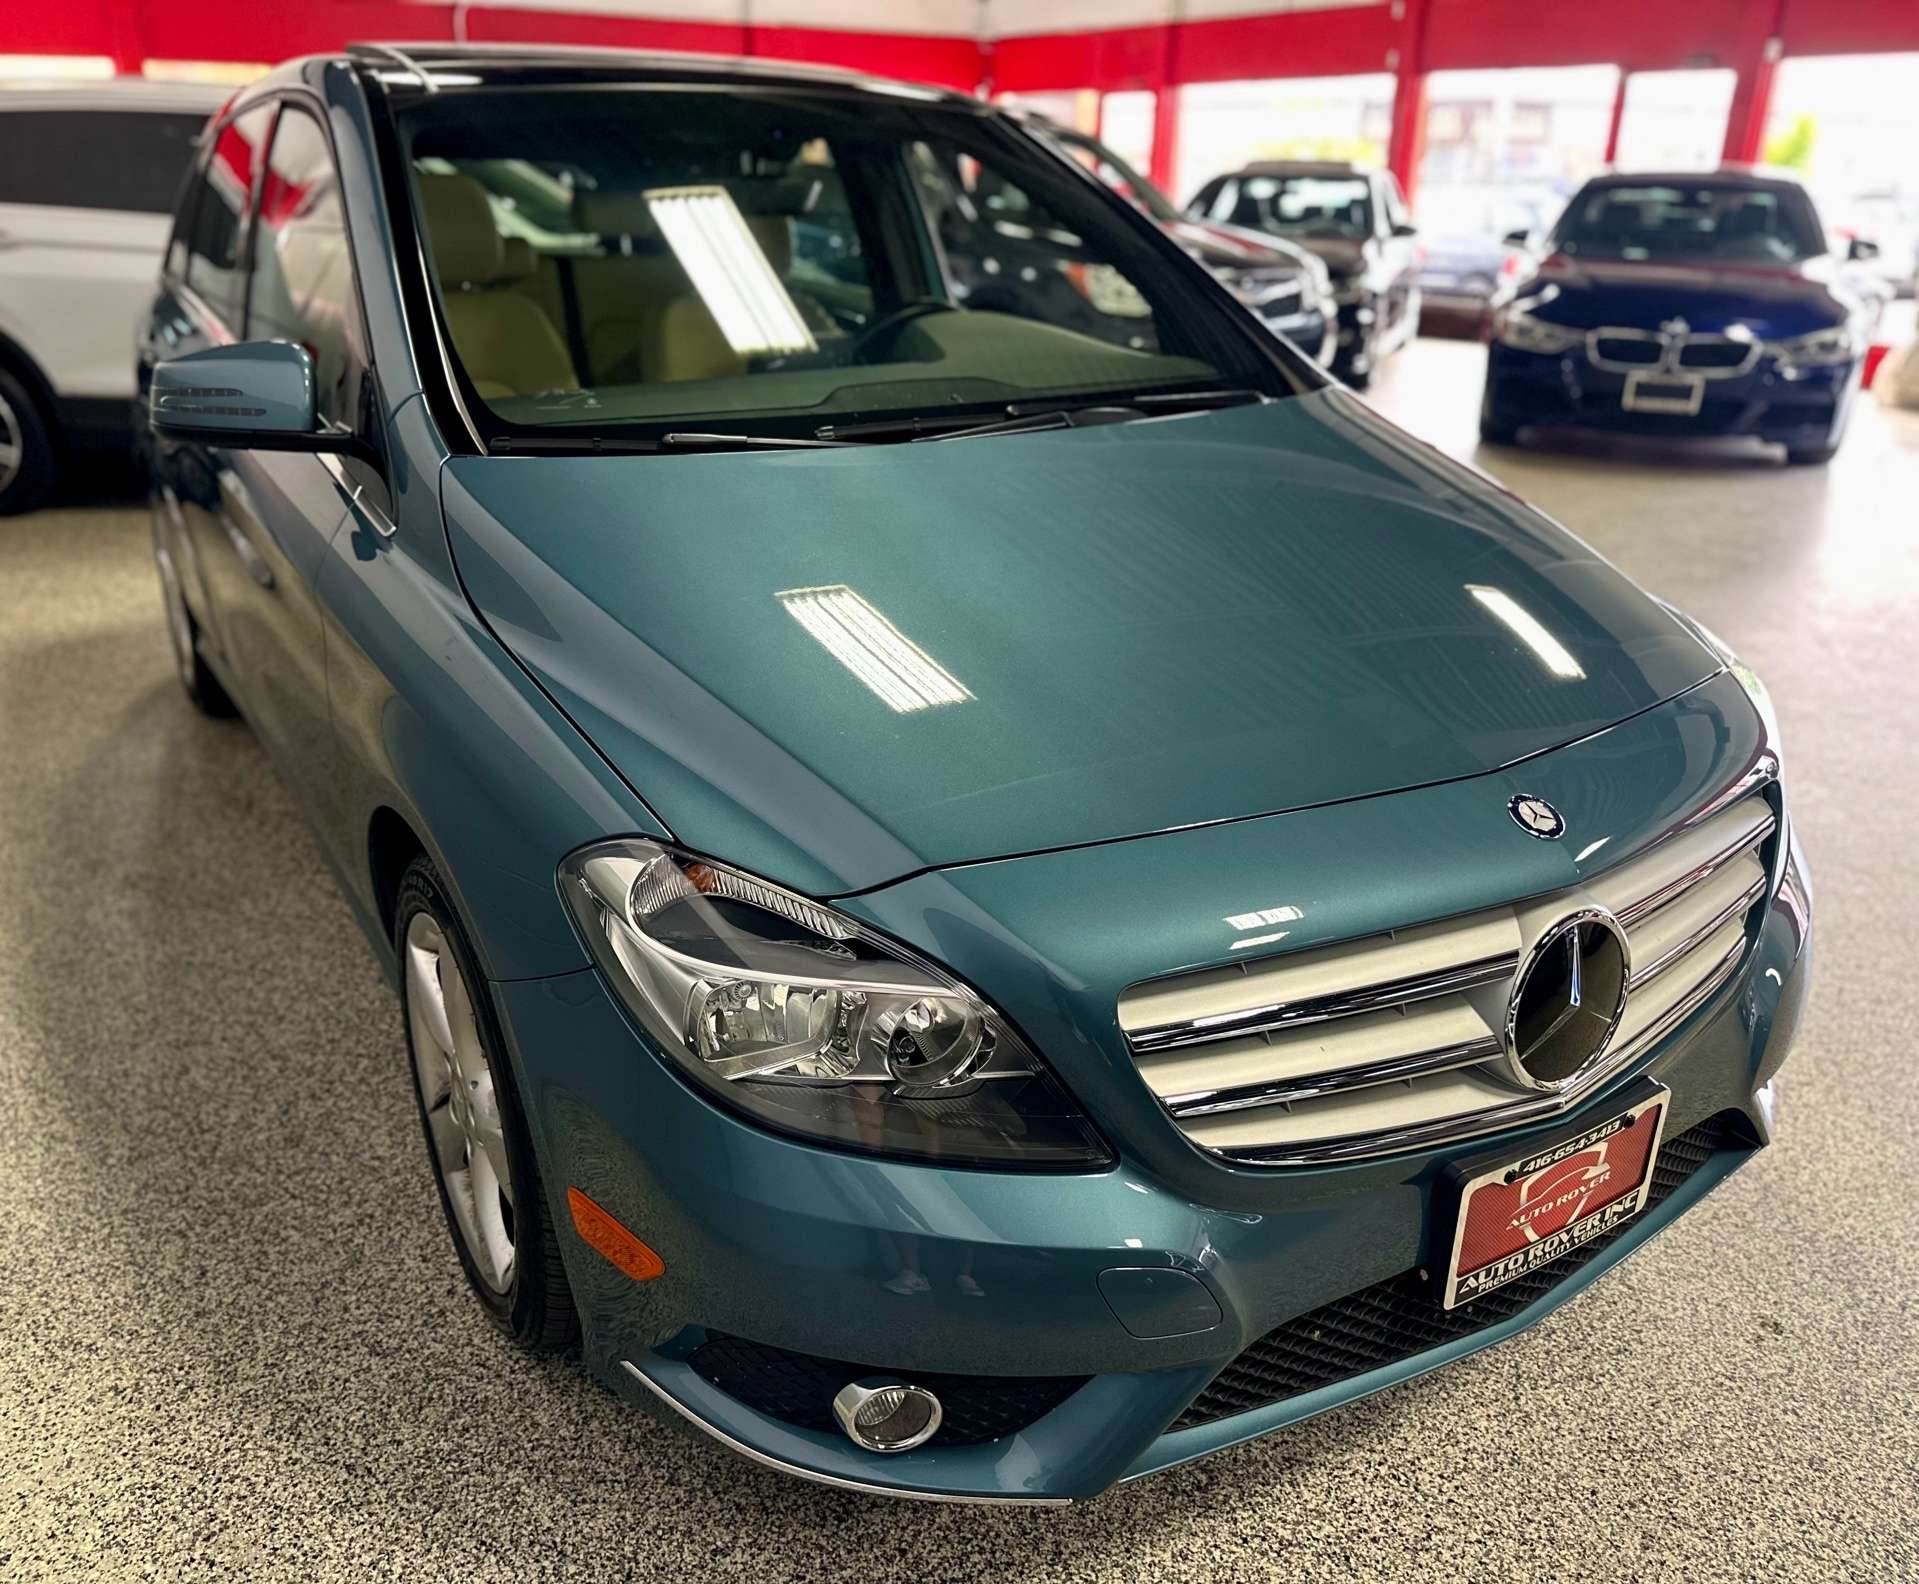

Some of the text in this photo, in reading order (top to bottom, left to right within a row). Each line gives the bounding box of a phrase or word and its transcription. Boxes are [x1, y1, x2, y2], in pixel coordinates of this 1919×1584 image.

[1506, 1172, 1611, 1230] AUTO ROVER
[1459, 1191, 1638, 1294] AUTO ROVER INC
[1478, 1215, 1619, 1293] PREMIUM QUALITY VEHICLES
